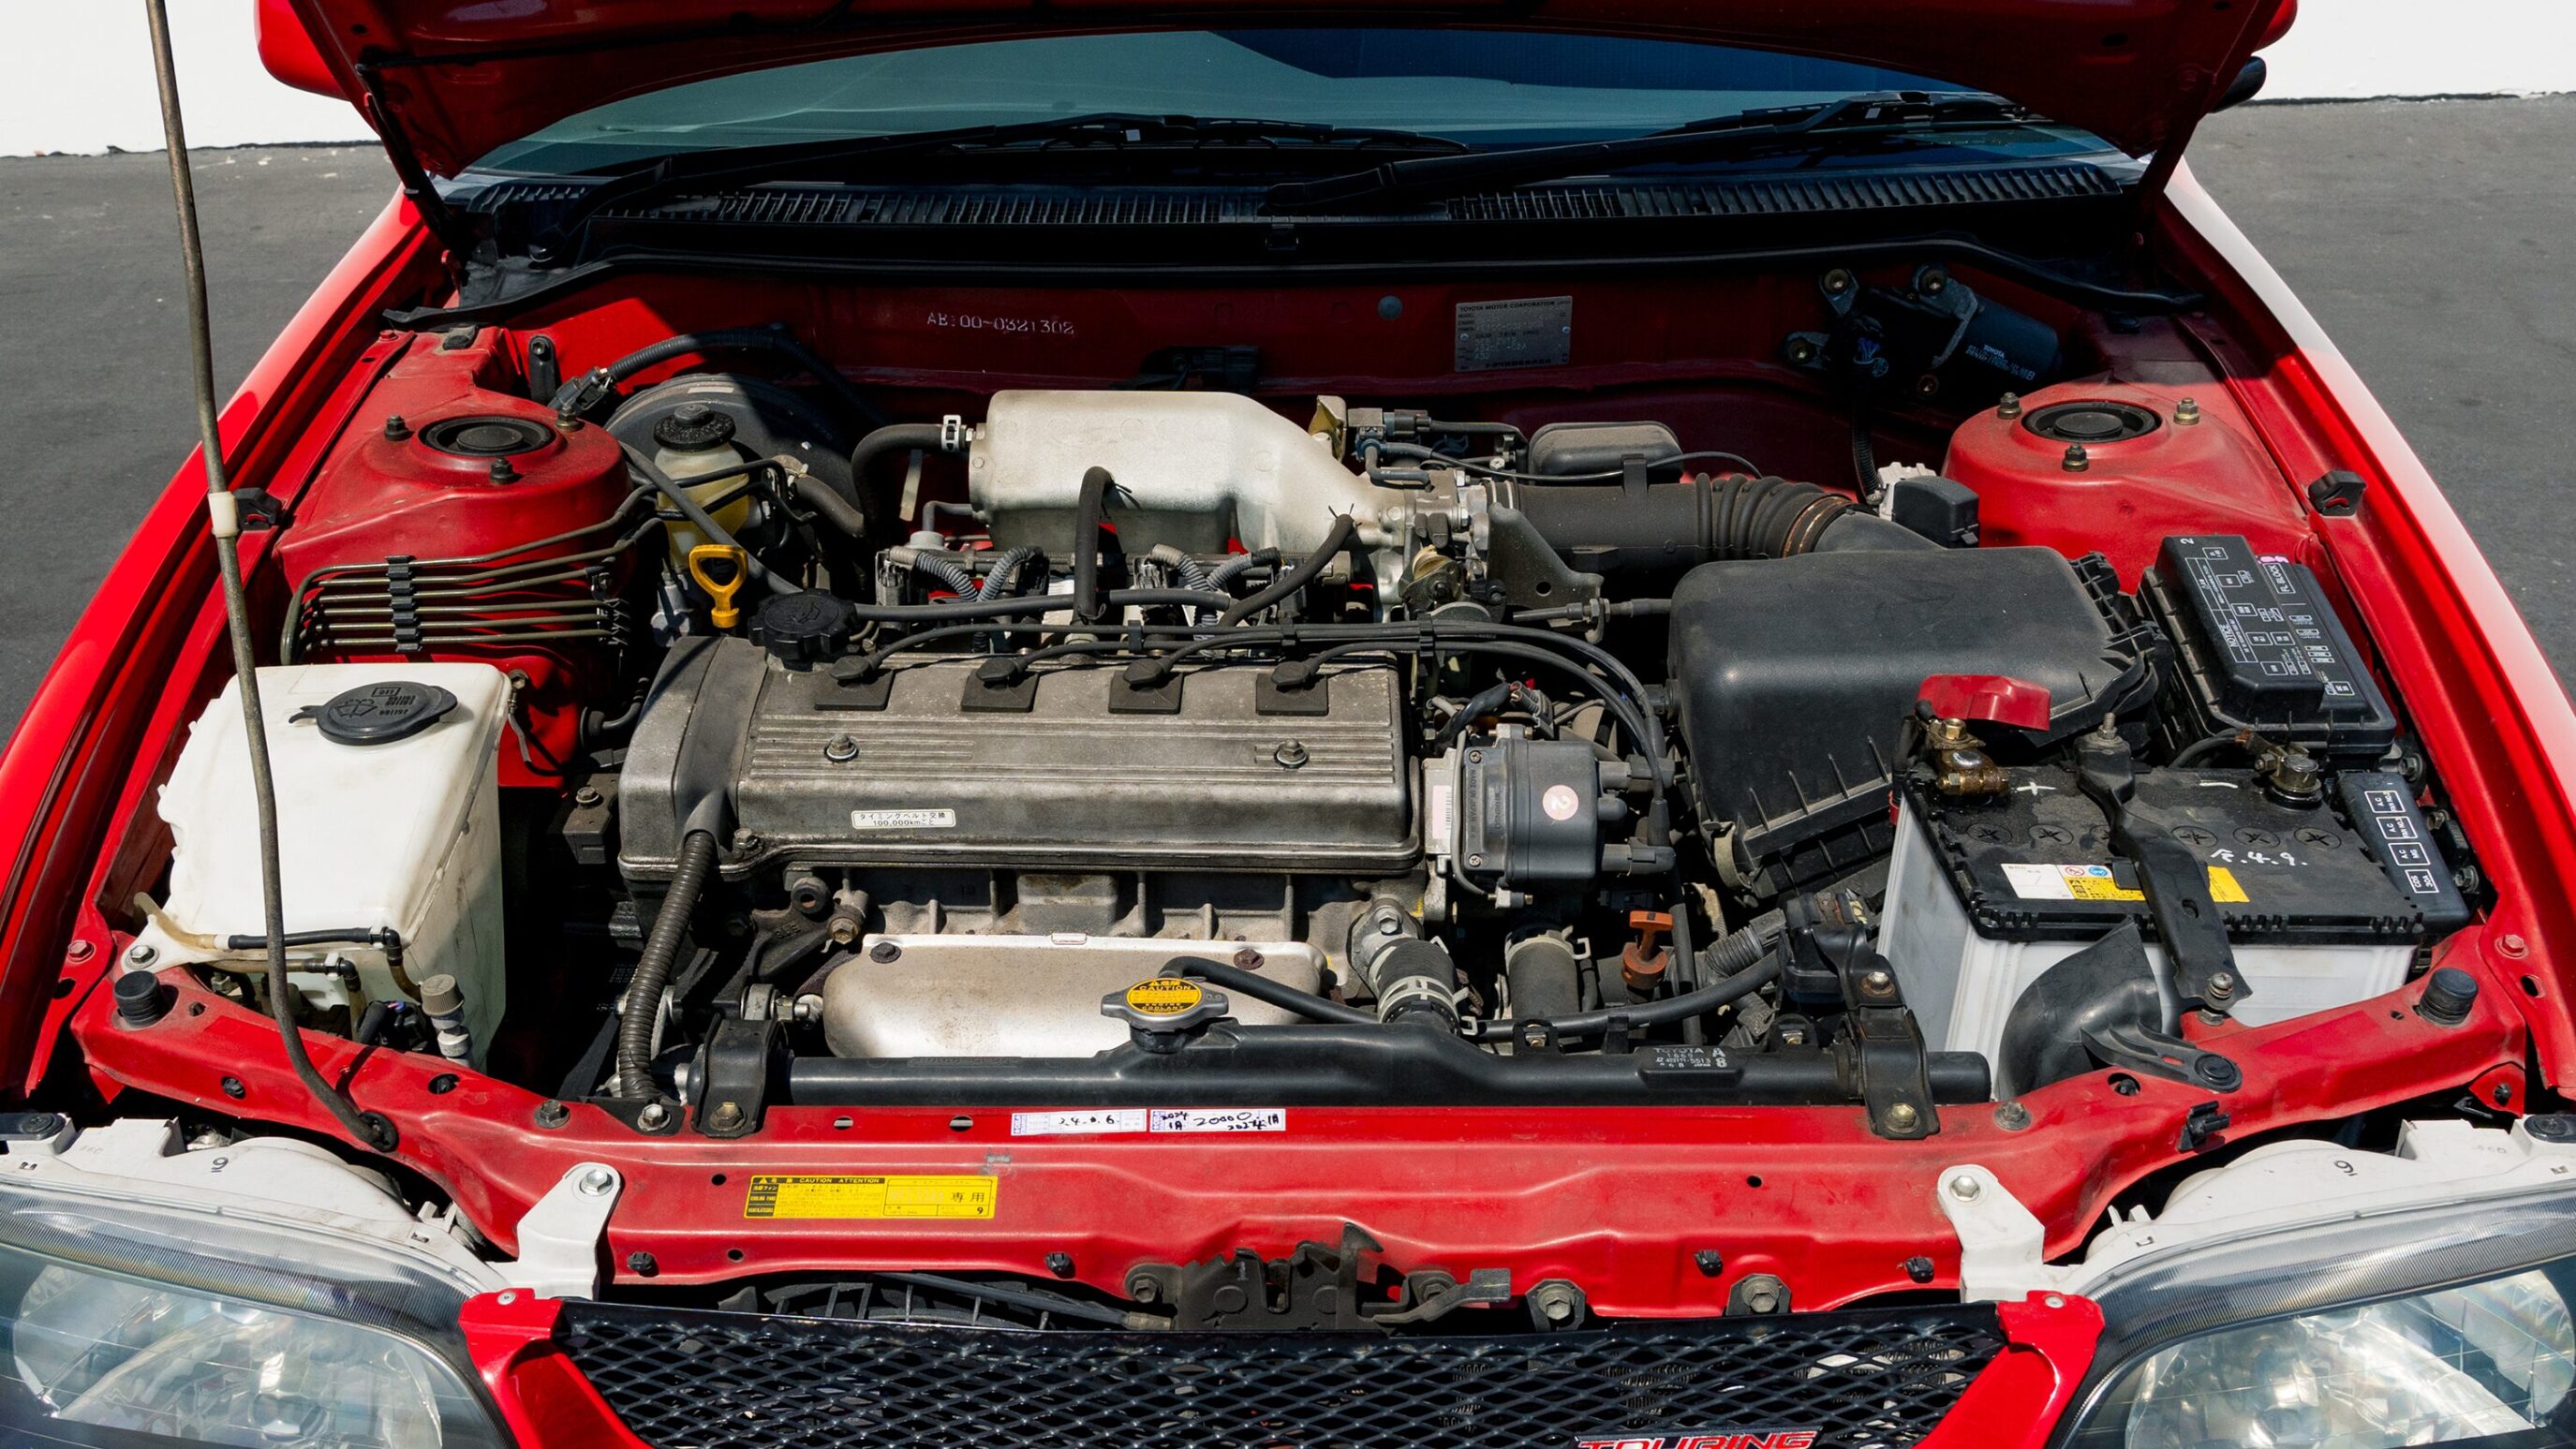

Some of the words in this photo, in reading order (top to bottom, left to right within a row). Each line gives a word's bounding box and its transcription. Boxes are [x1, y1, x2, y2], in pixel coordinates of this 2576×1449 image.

[1509, 301, 1555, 309] CORPORATION
[1983, 345, 2006, 360] TOYOTA
[2268, 564, 2287, 584] BLOCK
[2279, 584, 2290, 593] FL
[2422, 875, 2434, 888] 30A
